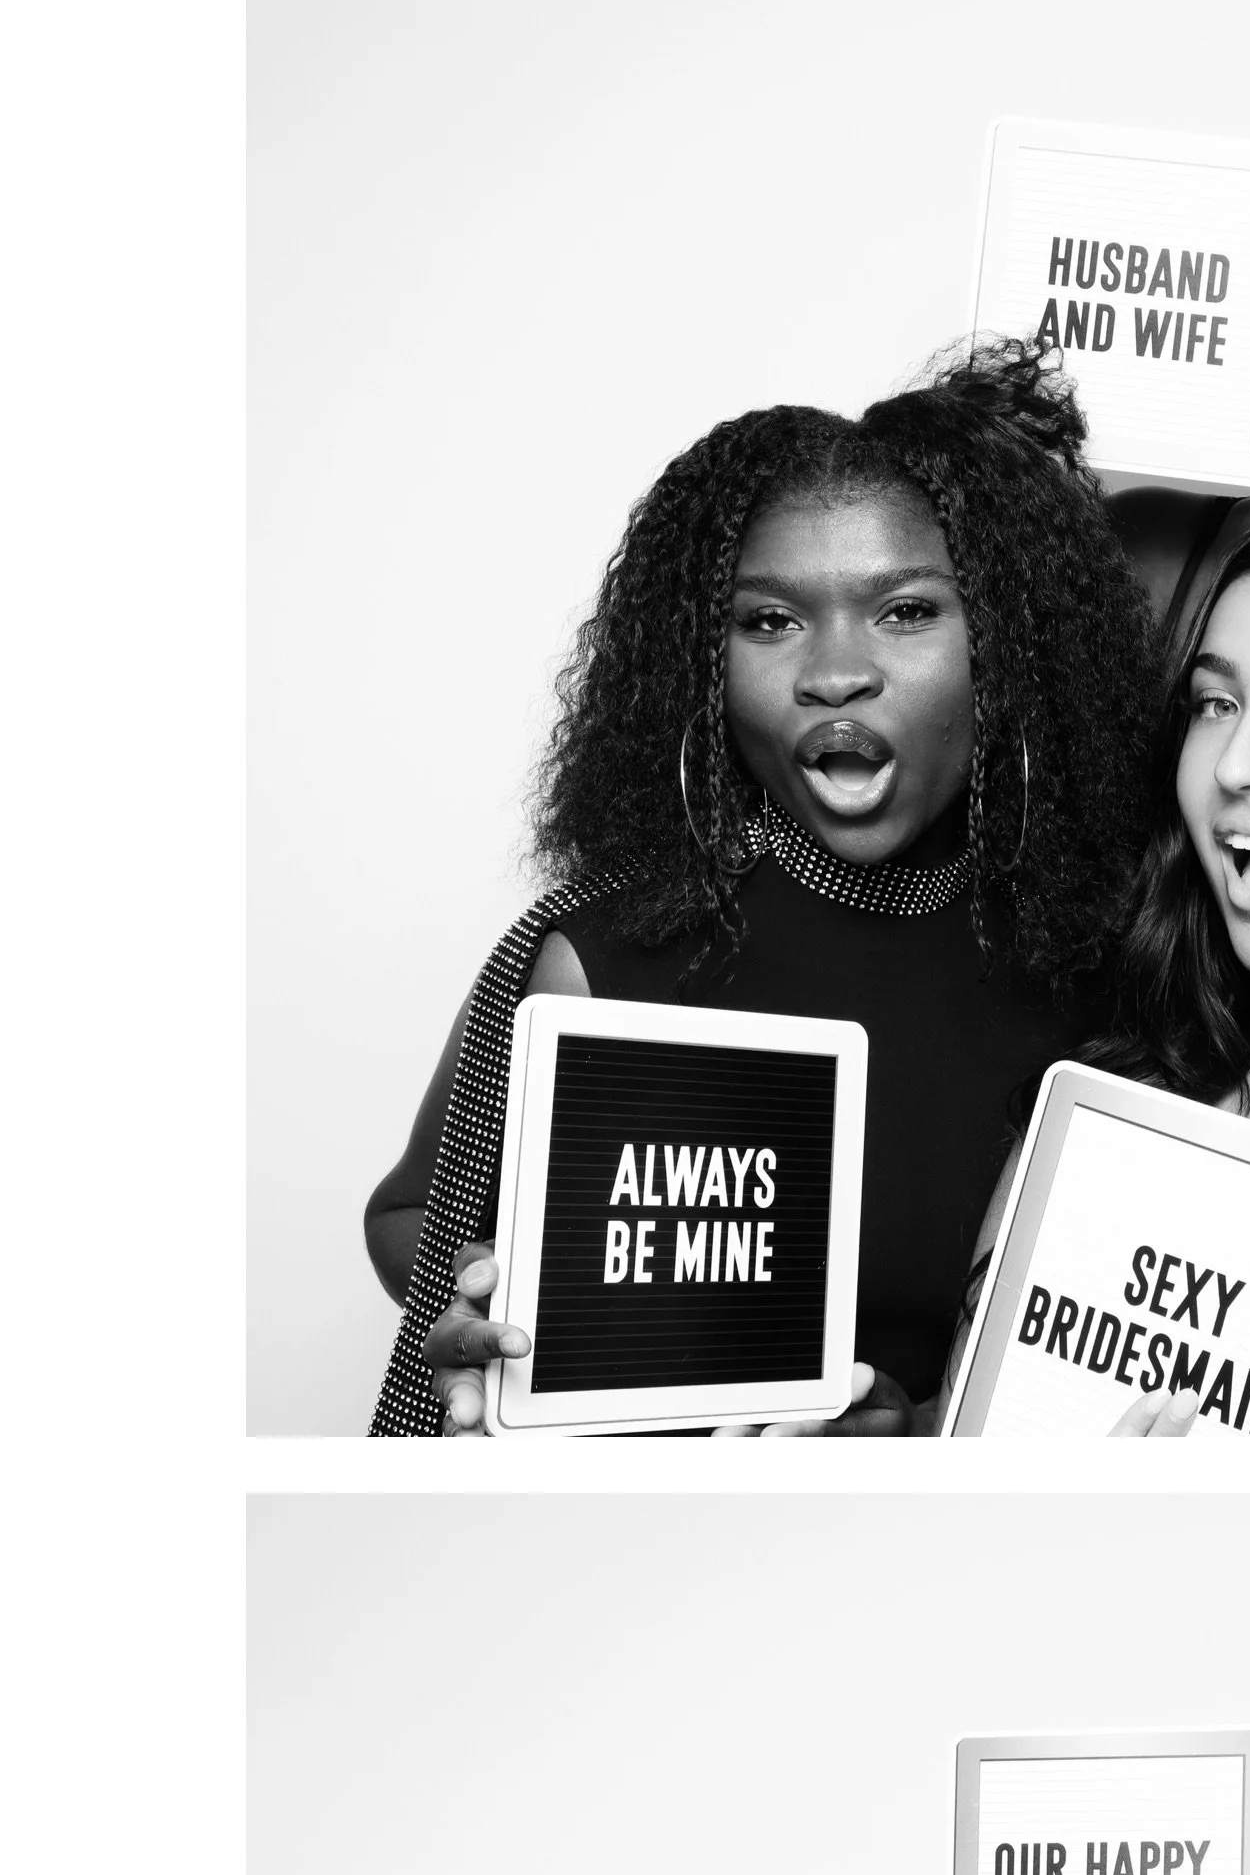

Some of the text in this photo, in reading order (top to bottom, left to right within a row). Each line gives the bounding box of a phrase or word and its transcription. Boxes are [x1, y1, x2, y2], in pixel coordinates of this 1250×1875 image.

[1048, 236, 1230, 304] HUSBAND
[1036, 297, 1229, 366] AND WIFE
[609, 1143, 776, 1209] ALWAYS
[604, 1220, 775, 1284] BE MINE
[1124, 1245, 1246, 1338] SEXY
